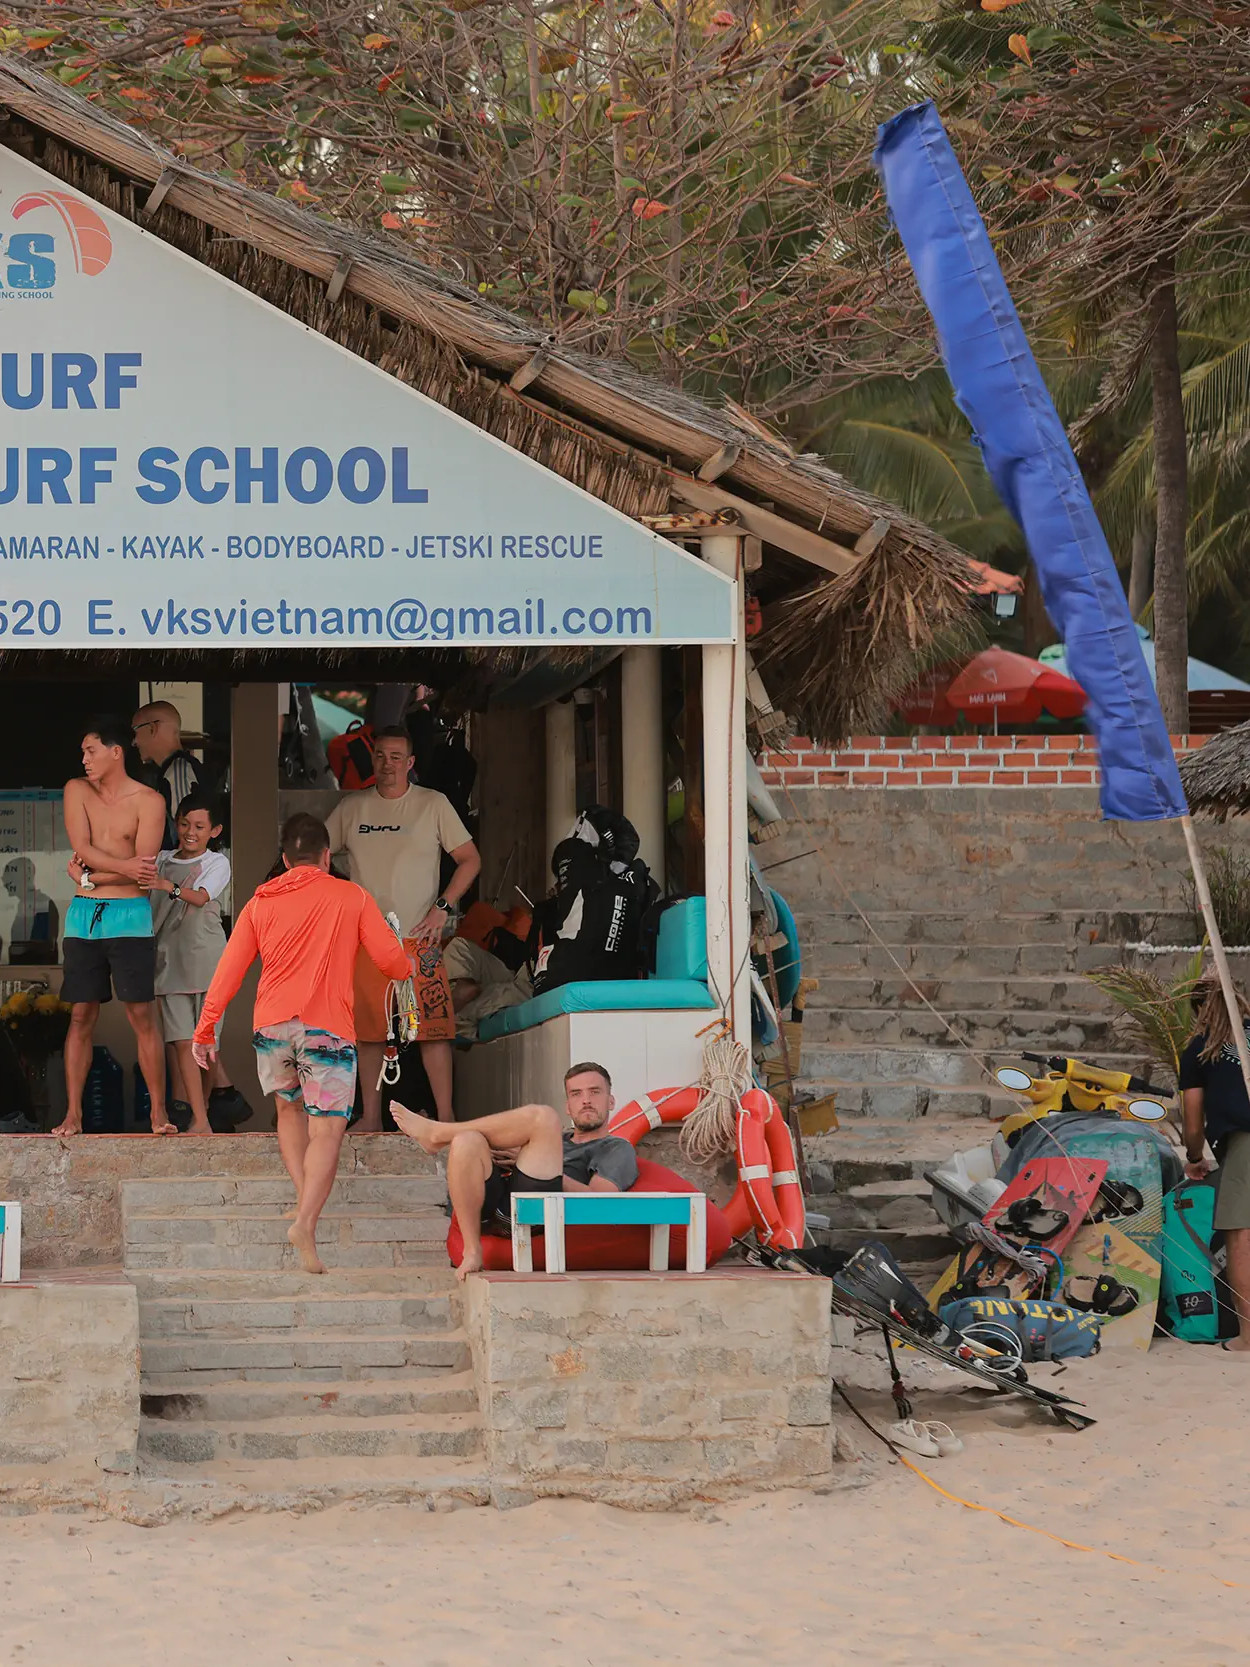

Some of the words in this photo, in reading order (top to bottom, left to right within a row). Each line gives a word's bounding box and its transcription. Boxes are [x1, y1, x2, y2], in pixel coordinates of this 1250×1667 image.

[17, 291, 55, 300] SCHOOL
[134, 446, 429, 505] SCHOOL
[122, 535, 205, 560] KAYAK
[226, 535, 385, 559] BODYBOARD
[405, 534, 493, 559] JETSKI
[501, 534, 604, 559] RESCUE
[87, 599, 126, 636] E.
[140, 597, 653, 641] vksvietnam@gmail.com
[359, 824, 401, 834] guru
[605, 895, 623, 951] CORE
